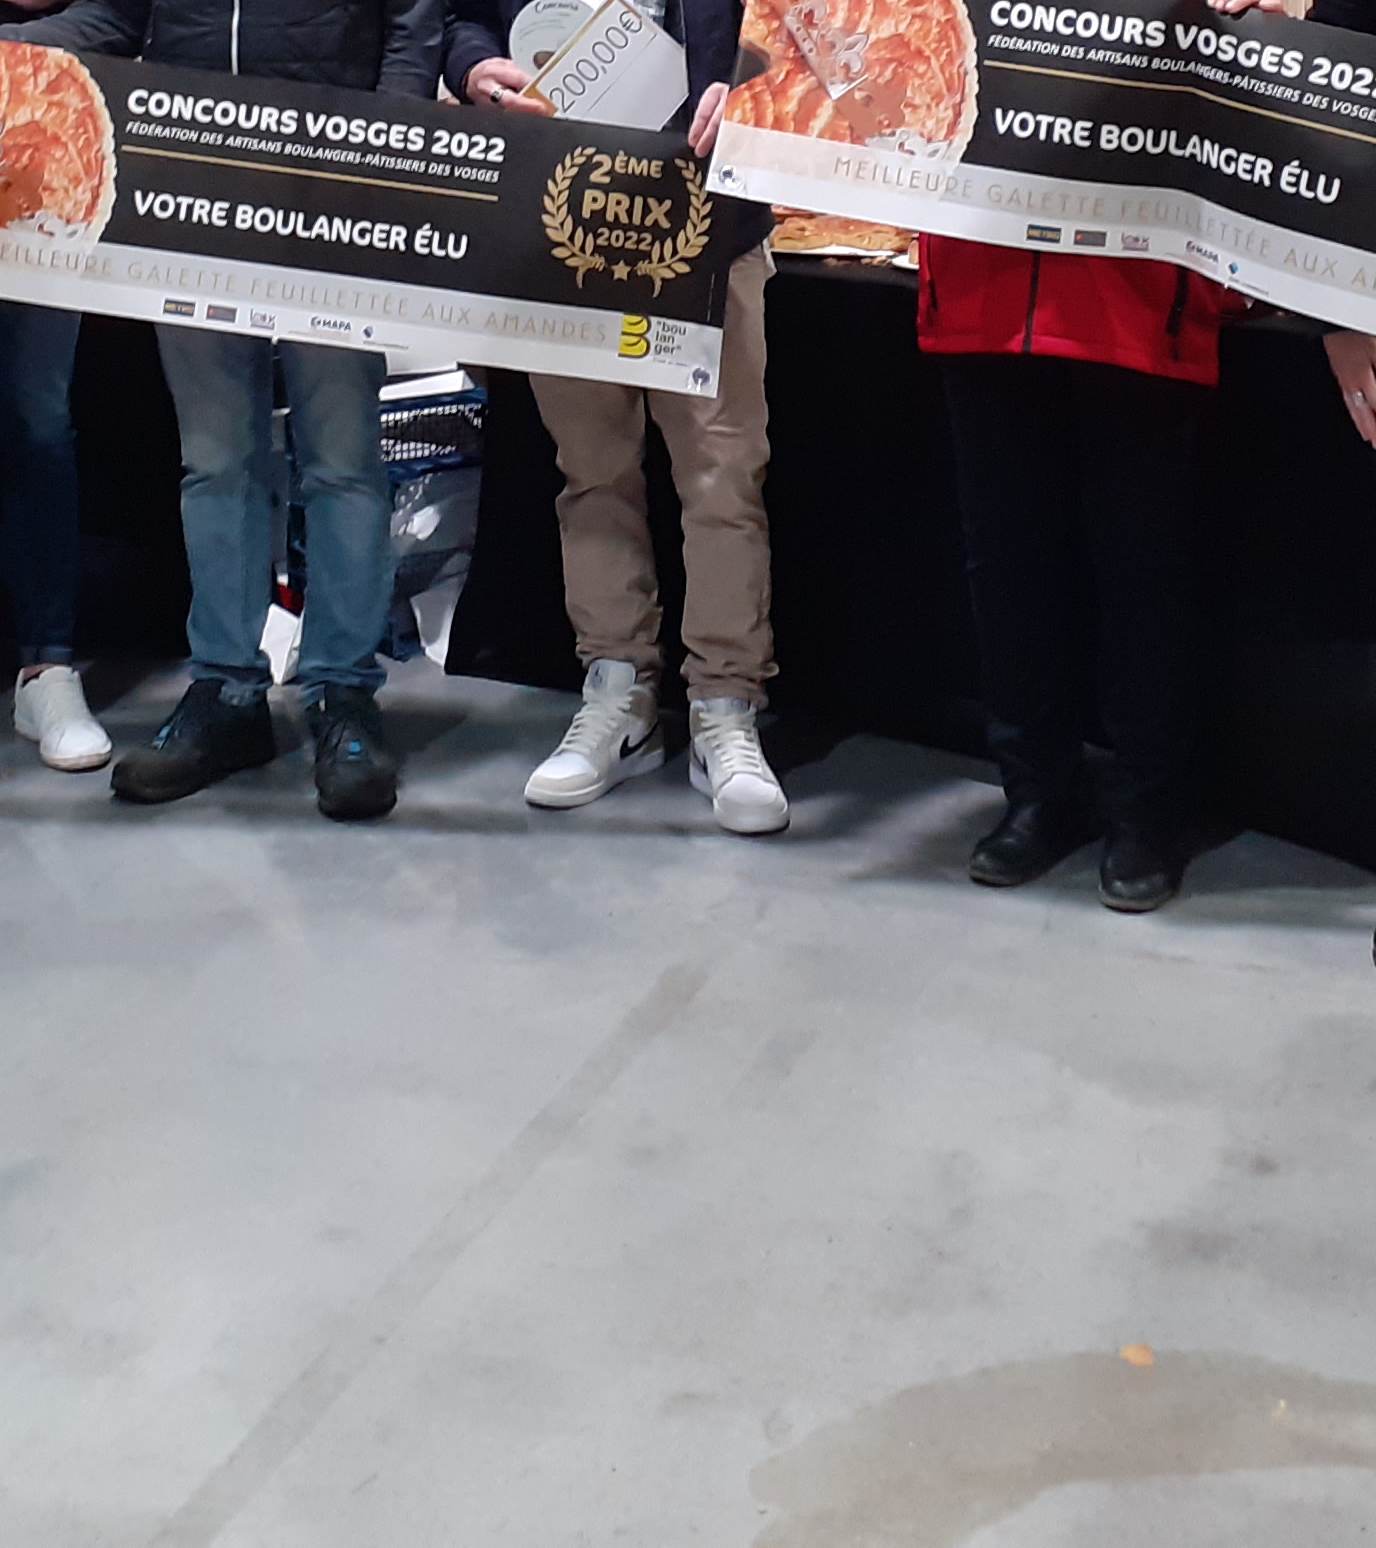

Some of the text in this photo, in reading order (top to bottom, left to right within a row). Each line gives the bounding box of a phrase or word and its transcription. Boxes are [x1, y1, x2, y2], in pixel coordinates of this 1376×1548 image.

[549, 10, 643, 114] 200,00€
[987, 34, 1060, 57] FÉDÉRATION
[1061, 44, 1085, 60] DES
[1086, 47, 1150, 69] ARTISANS
[1302, 92, 1330, 111] DES
[990, 0, 1166, 48] CONCOURS
[1174, 22, 1304, 79] VOSGES
[125, 120, 198, 142] FÉDÉRATION
[199, 132, 224, 146] DES
[224, 134, 283, 155] ARTISANS
[427, 160, 452, 176] DES
[454, 164, 500, 183] VOSGES
[126, 88, 506, 164] CONCOURS VOSGES 2022
[994, 107, 1342, 206] VOTRE BOULANGER ÉLU
[589, 150, 665, 185] 2ÈME
[133, 189, 469, 261] VOTRE BOULANGER ÉLU
[581, 189, 673, 229] PRIX
[596, 227, 653, 251] 2022
[833, 156, 973, 199] MEILLEURE
[987, 184, 1105, 218] GALETTE
[1283, 250, 1336, 278] AUX
[127, 262, 235, 294] GALETTE
[250, 279, 410, 316] FEUILLETTÉE
[423, 301, 471, 325] AUX
[484, 311, 606, 342] AMANDES
[655, 332, 675, 343] lan
